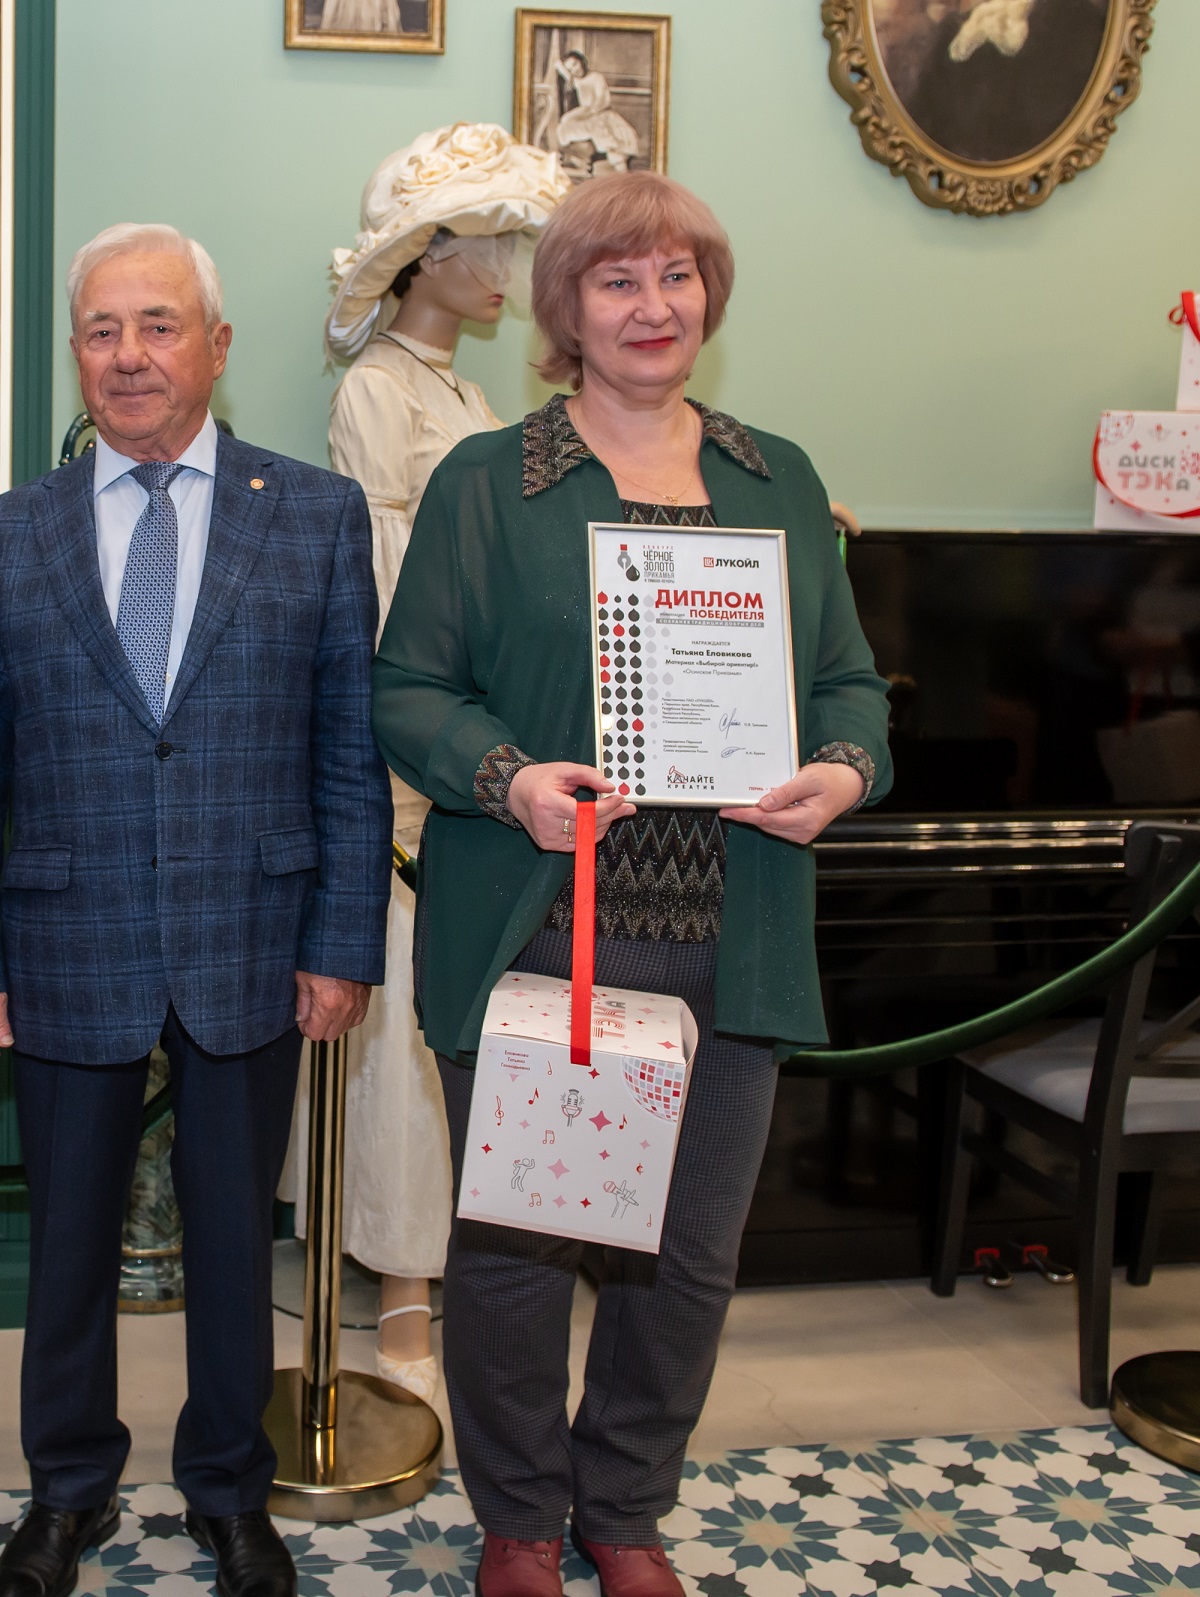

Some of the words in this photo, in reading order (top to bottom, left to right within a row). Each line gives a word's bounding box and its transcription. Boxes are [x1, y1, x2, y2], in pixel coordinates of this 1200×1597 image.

[643, 549, 674, 561] ЧЁРНОЕ
[643, 561, 675, 572] ЗОЛОТО
[715, 558, 760, 569] ЛУКОЙЛ
[655, 589, 763, 609] ДИПЛОМ
[690, 609, 764, 620] ПОБЕДИТЕЛЯ
[671, 648, 704, 656] Татьяна
[706, 650, 752, 658] Еловикова
